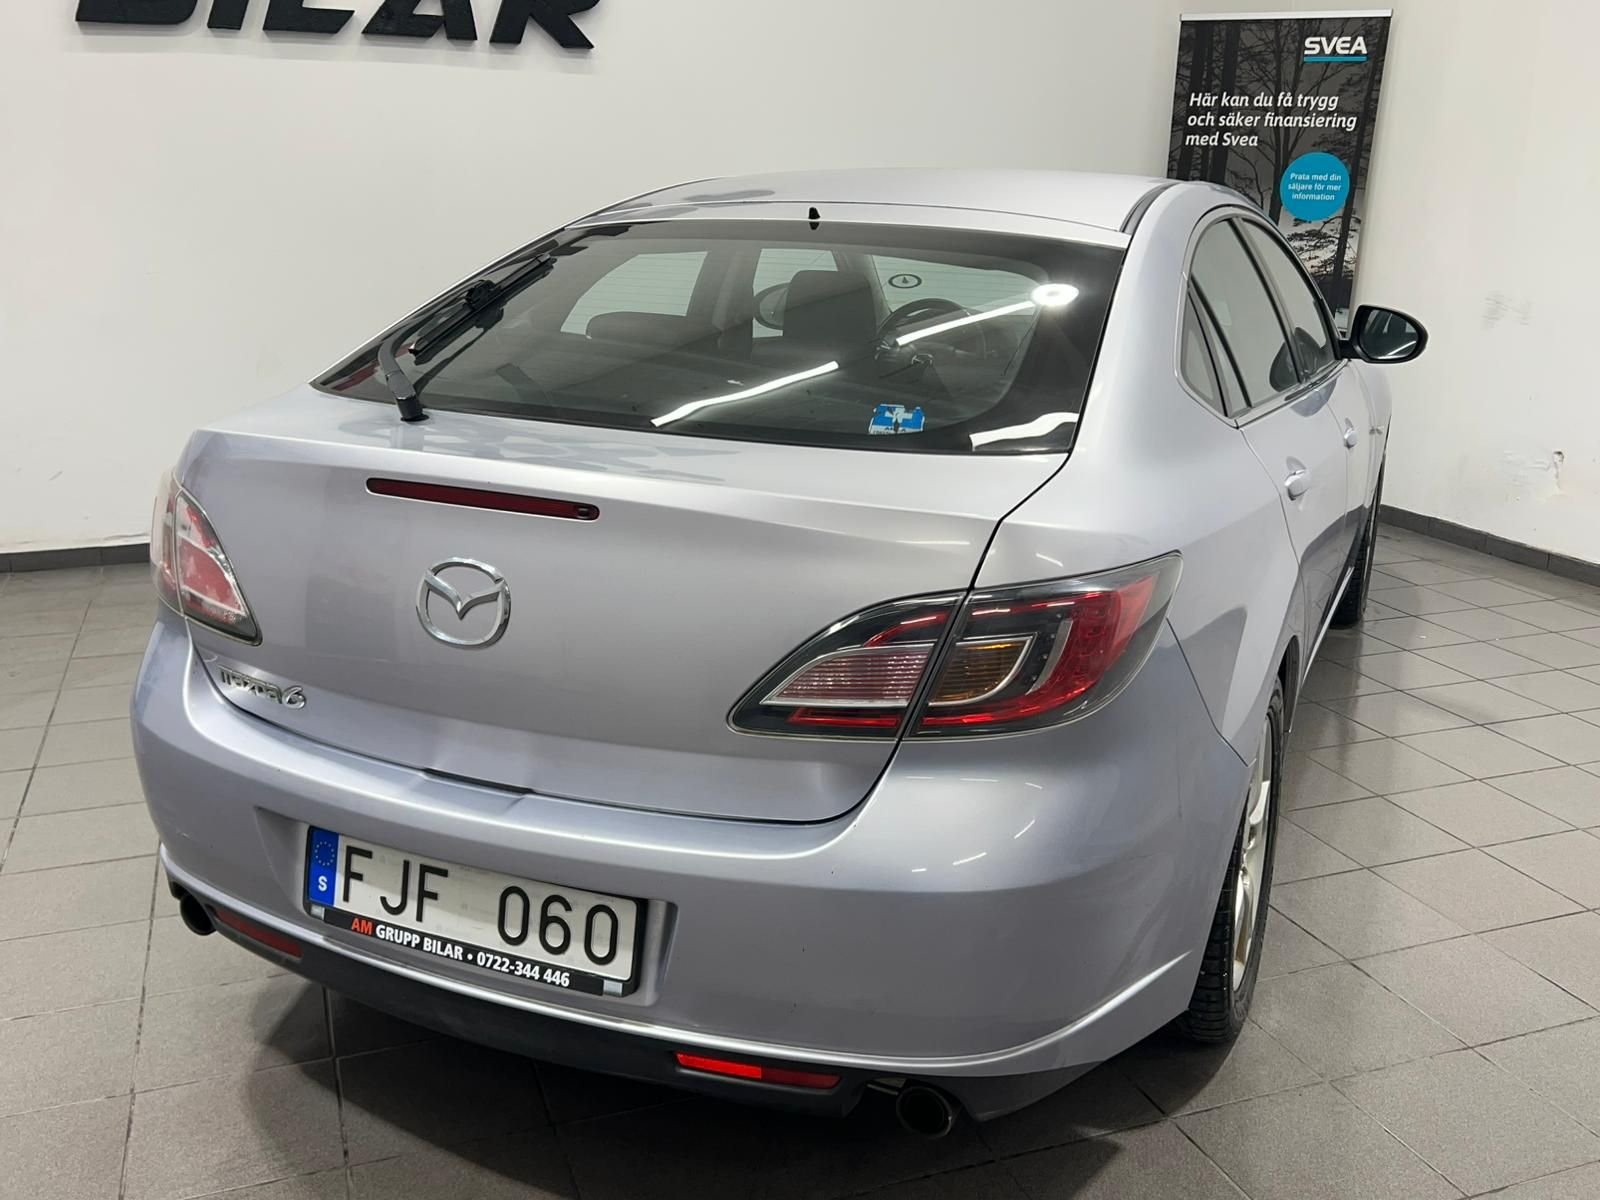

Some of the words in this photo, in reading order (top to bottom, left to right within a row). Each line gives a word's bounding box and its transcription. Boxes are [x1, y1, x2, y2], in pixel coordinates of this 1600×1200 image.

[1303, 36, 1368, 55] SVEA
[1189, 92, 1218, 107] Här
[1221, 92, 1249, 107] kan
[1253, 92, 1273, 107] du
[1276, 92, 1293, 109] få
[1297, 93, 1339, 111] trygg
[1187, 112, 1214, 127] och
[1218, 112, 1261, 128] säker
[1263, 112, 1358, 131] finansiering
[1185, 132, 1218, 146] med
[1221, 133, 1258, 147] Svea
[1290, 173, 1310, 181] Prata
[1311, 173, 1328, 181] med
[1287, 182, 1313, 191] säljare
[1314, 182, 1325, 191] för
[1291, 191, 1335, 201] information
[317, 875, 328, 893] S
[342, 844, 449, 923] FJF
[497, 885, 619, 966] 060
[351, 917, 373, 936] AM
[375, 924, 420, 949] GRUPP
[422, 938, 463, 961] BILAR
[476, 952, 540, 981] 0722-344
[543, 969, 571, 988] 446
